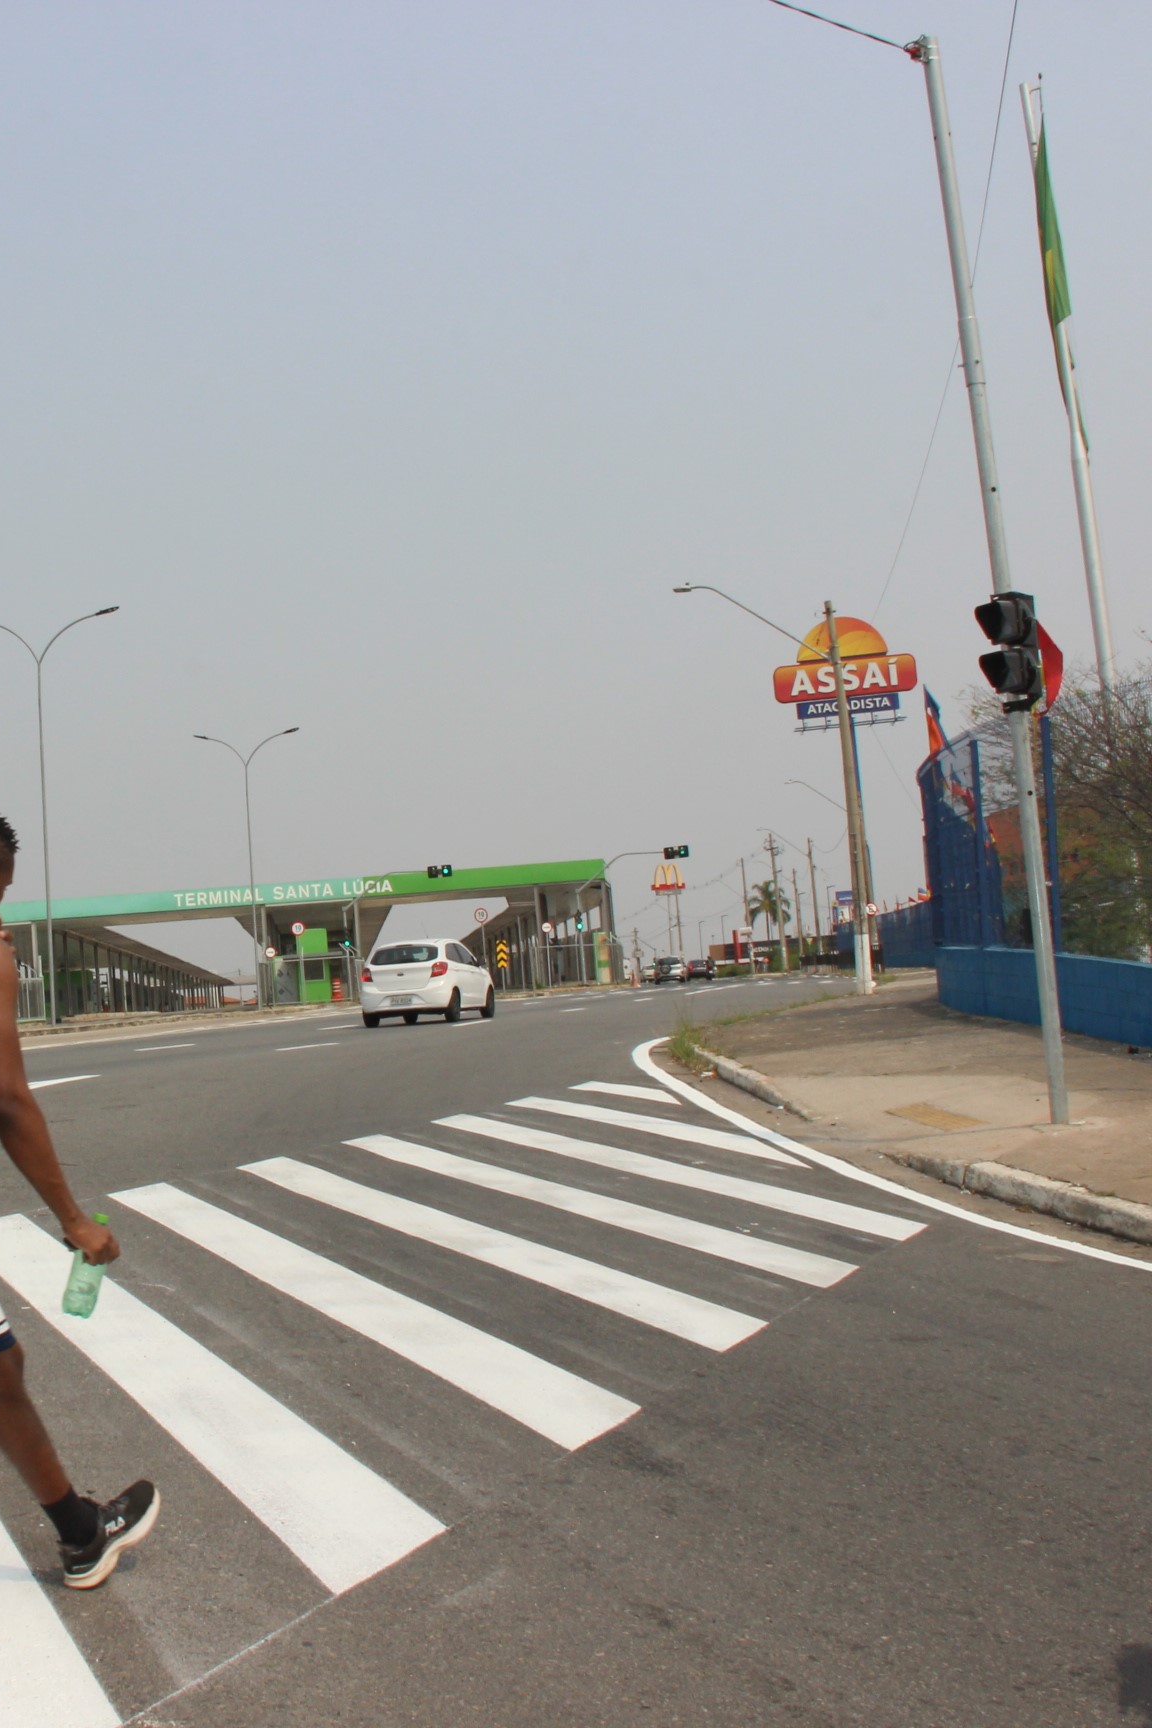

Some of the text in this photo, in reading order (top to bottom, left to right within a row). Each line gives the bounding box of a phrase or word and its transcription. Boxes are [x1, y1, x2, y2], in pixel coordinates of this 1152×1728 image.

[807, 697, 891, 715] ATACDISTA
[174, 878, 394, 908] TERMINAL SANTA LÚCIA
[104, 1515, 126, 1537] FILA
